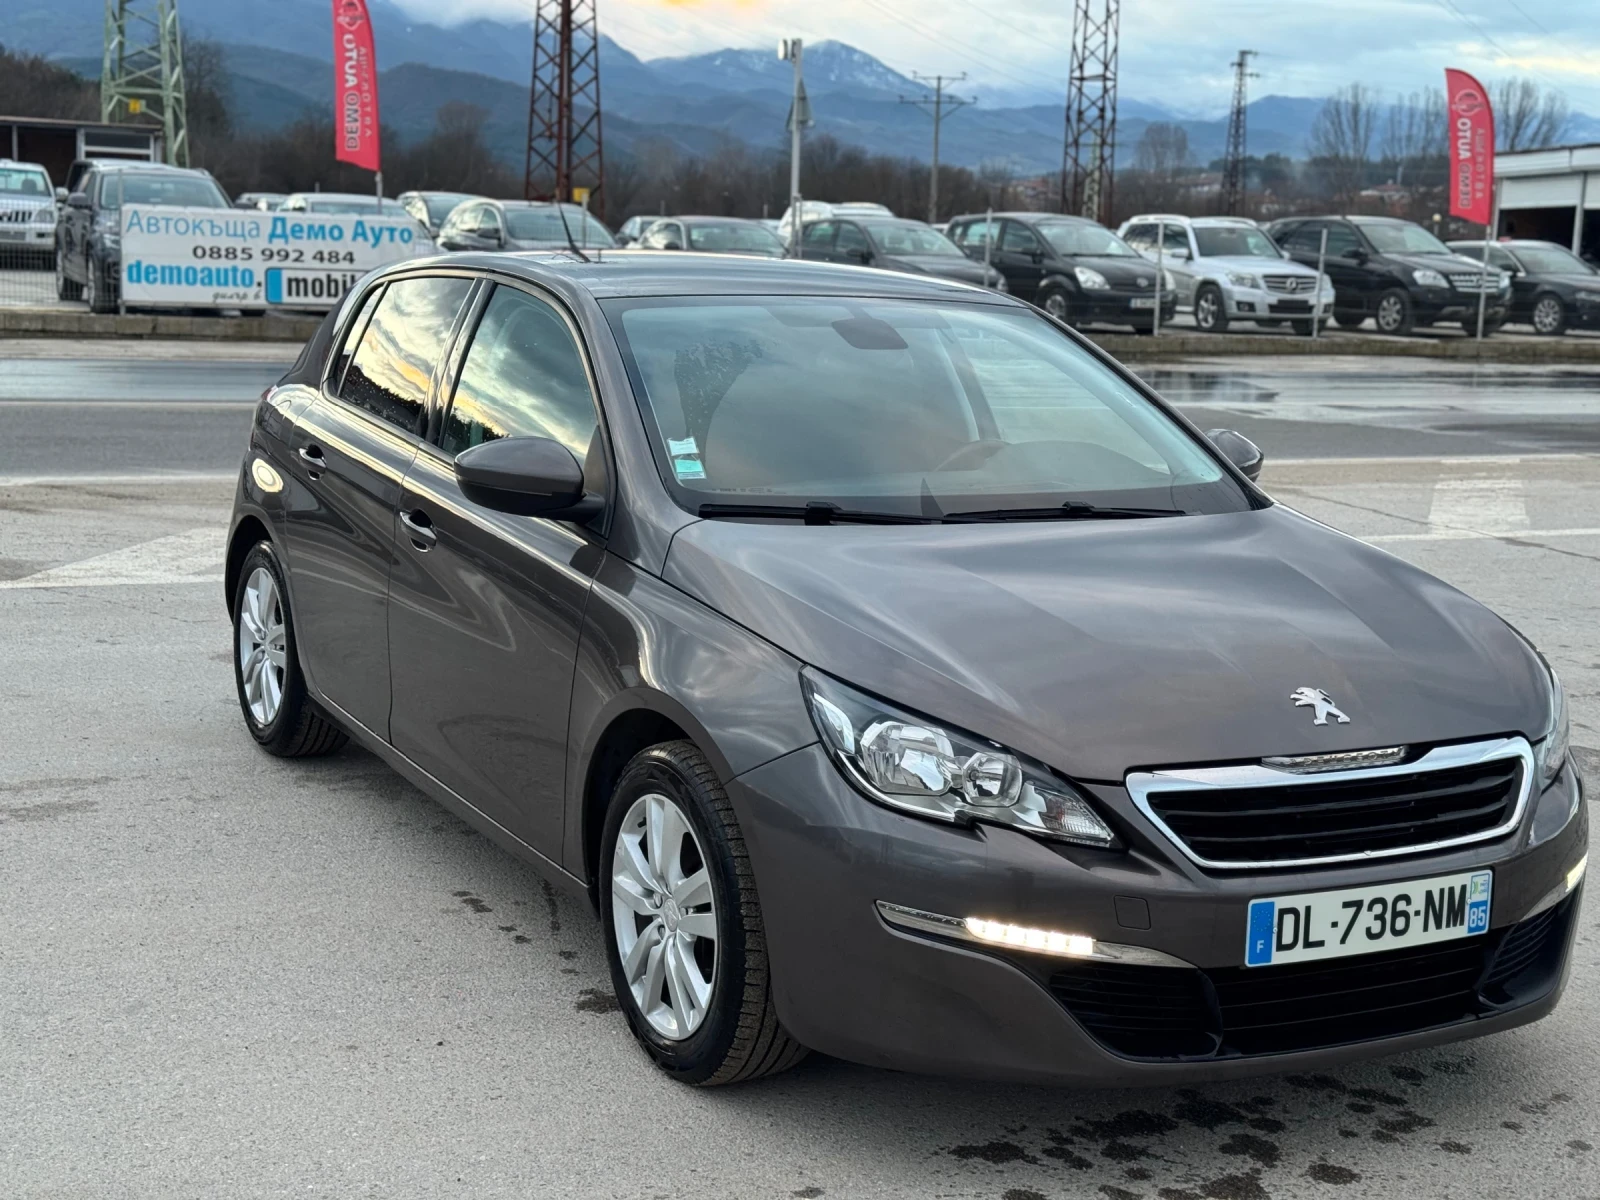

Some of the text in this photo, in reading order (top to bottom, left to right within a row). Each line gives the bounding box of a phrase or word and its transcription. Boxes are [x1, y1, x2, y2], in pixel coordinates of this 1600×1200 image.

[126, 210, 413, 248] Автокъща Демо Ауто
[192, 245, 356, 264] 0885 992 484
[1256, 939, 1265, 953] F
[1275, 884, 1468, 952] DL-736-NM
[1469, 906, 1487, 928] 85
